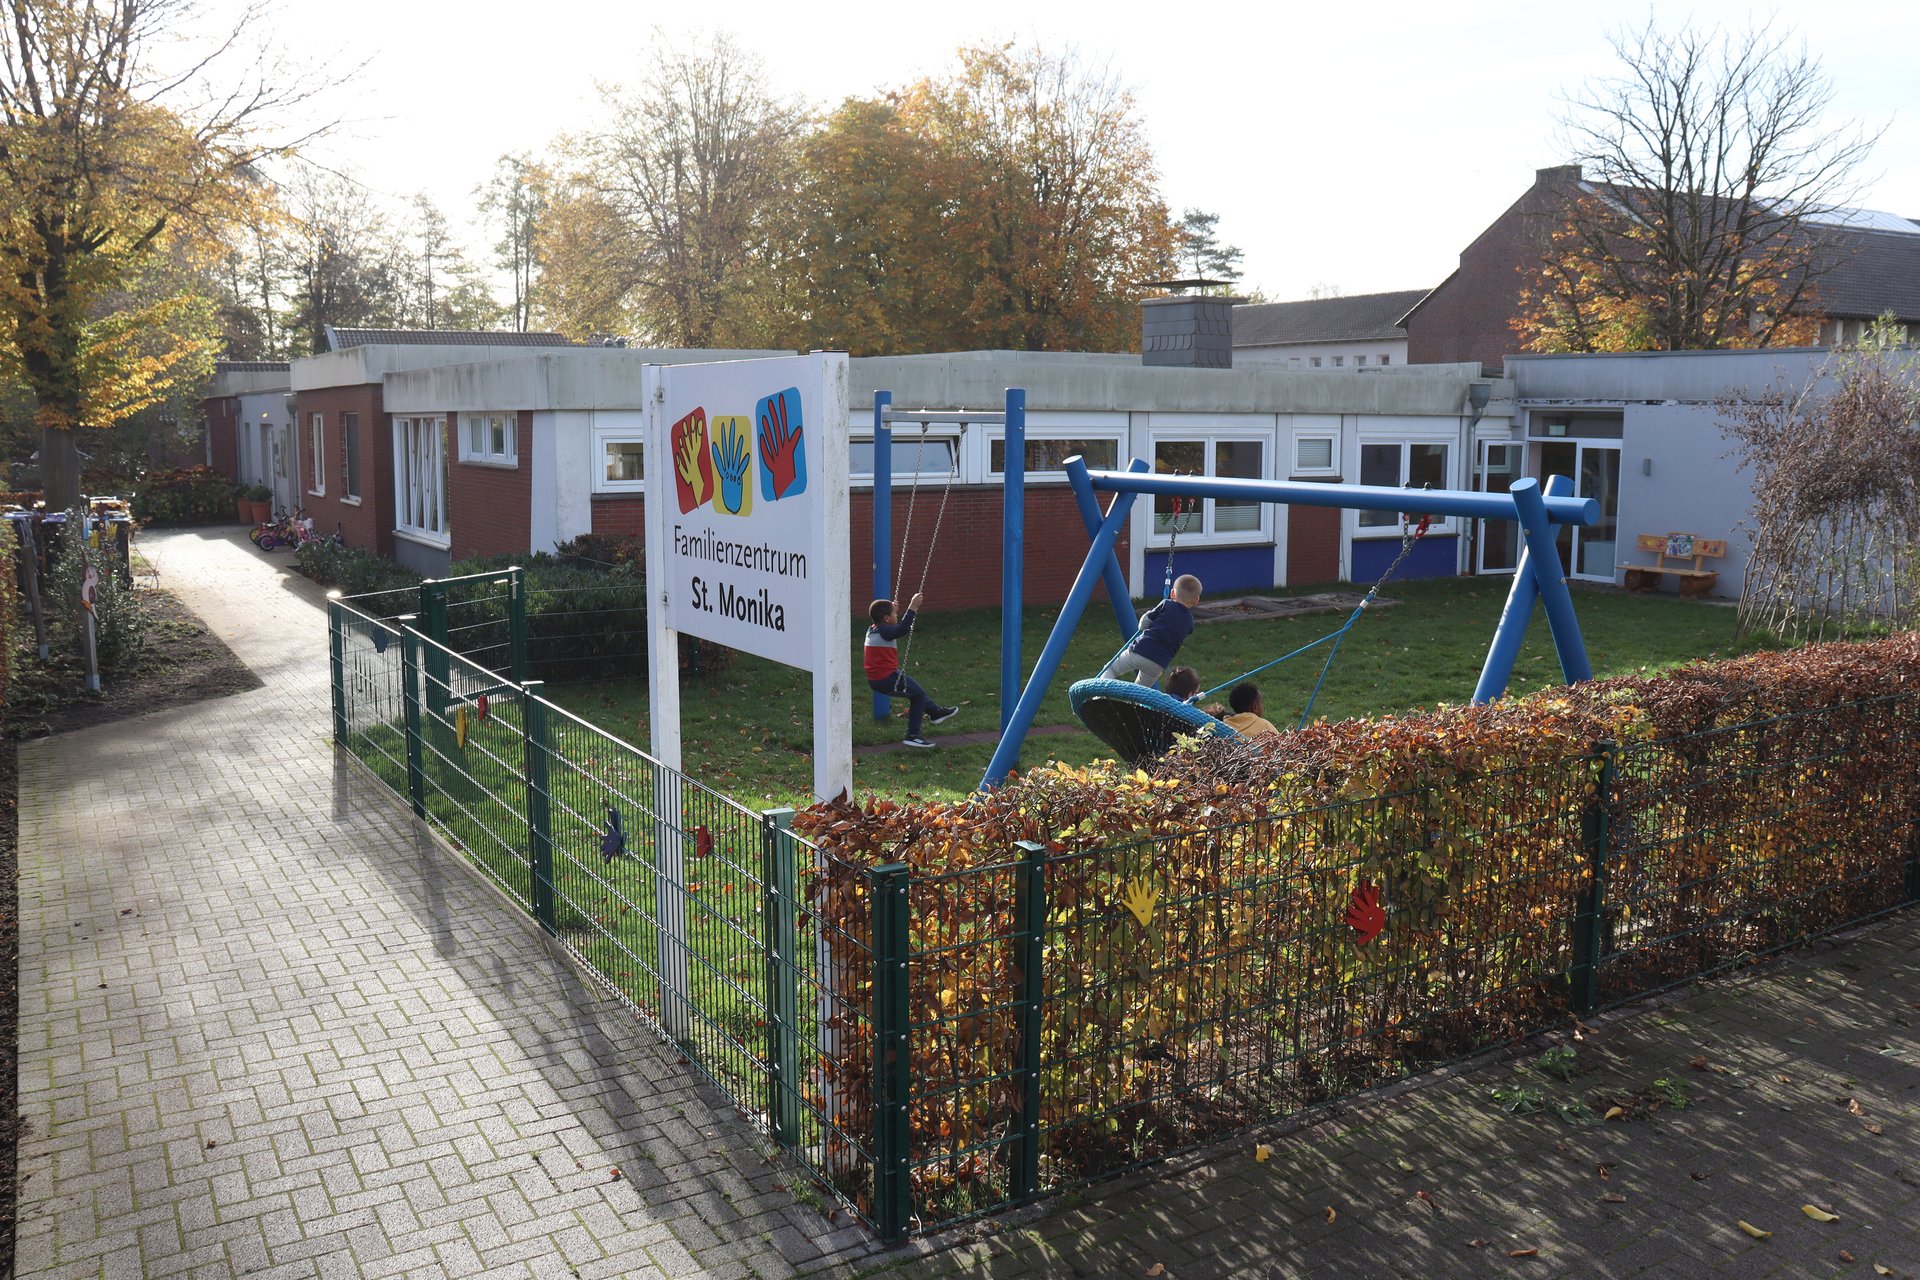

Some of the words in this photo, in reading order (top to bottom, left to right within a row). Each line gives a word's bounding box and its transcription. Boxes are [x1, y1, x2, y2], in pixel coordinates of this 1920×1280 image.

[674, 525, 807, 579] Familienzentrum
[691, 576, 713, 613] St.
[719, 582, 785, 632] Monika
